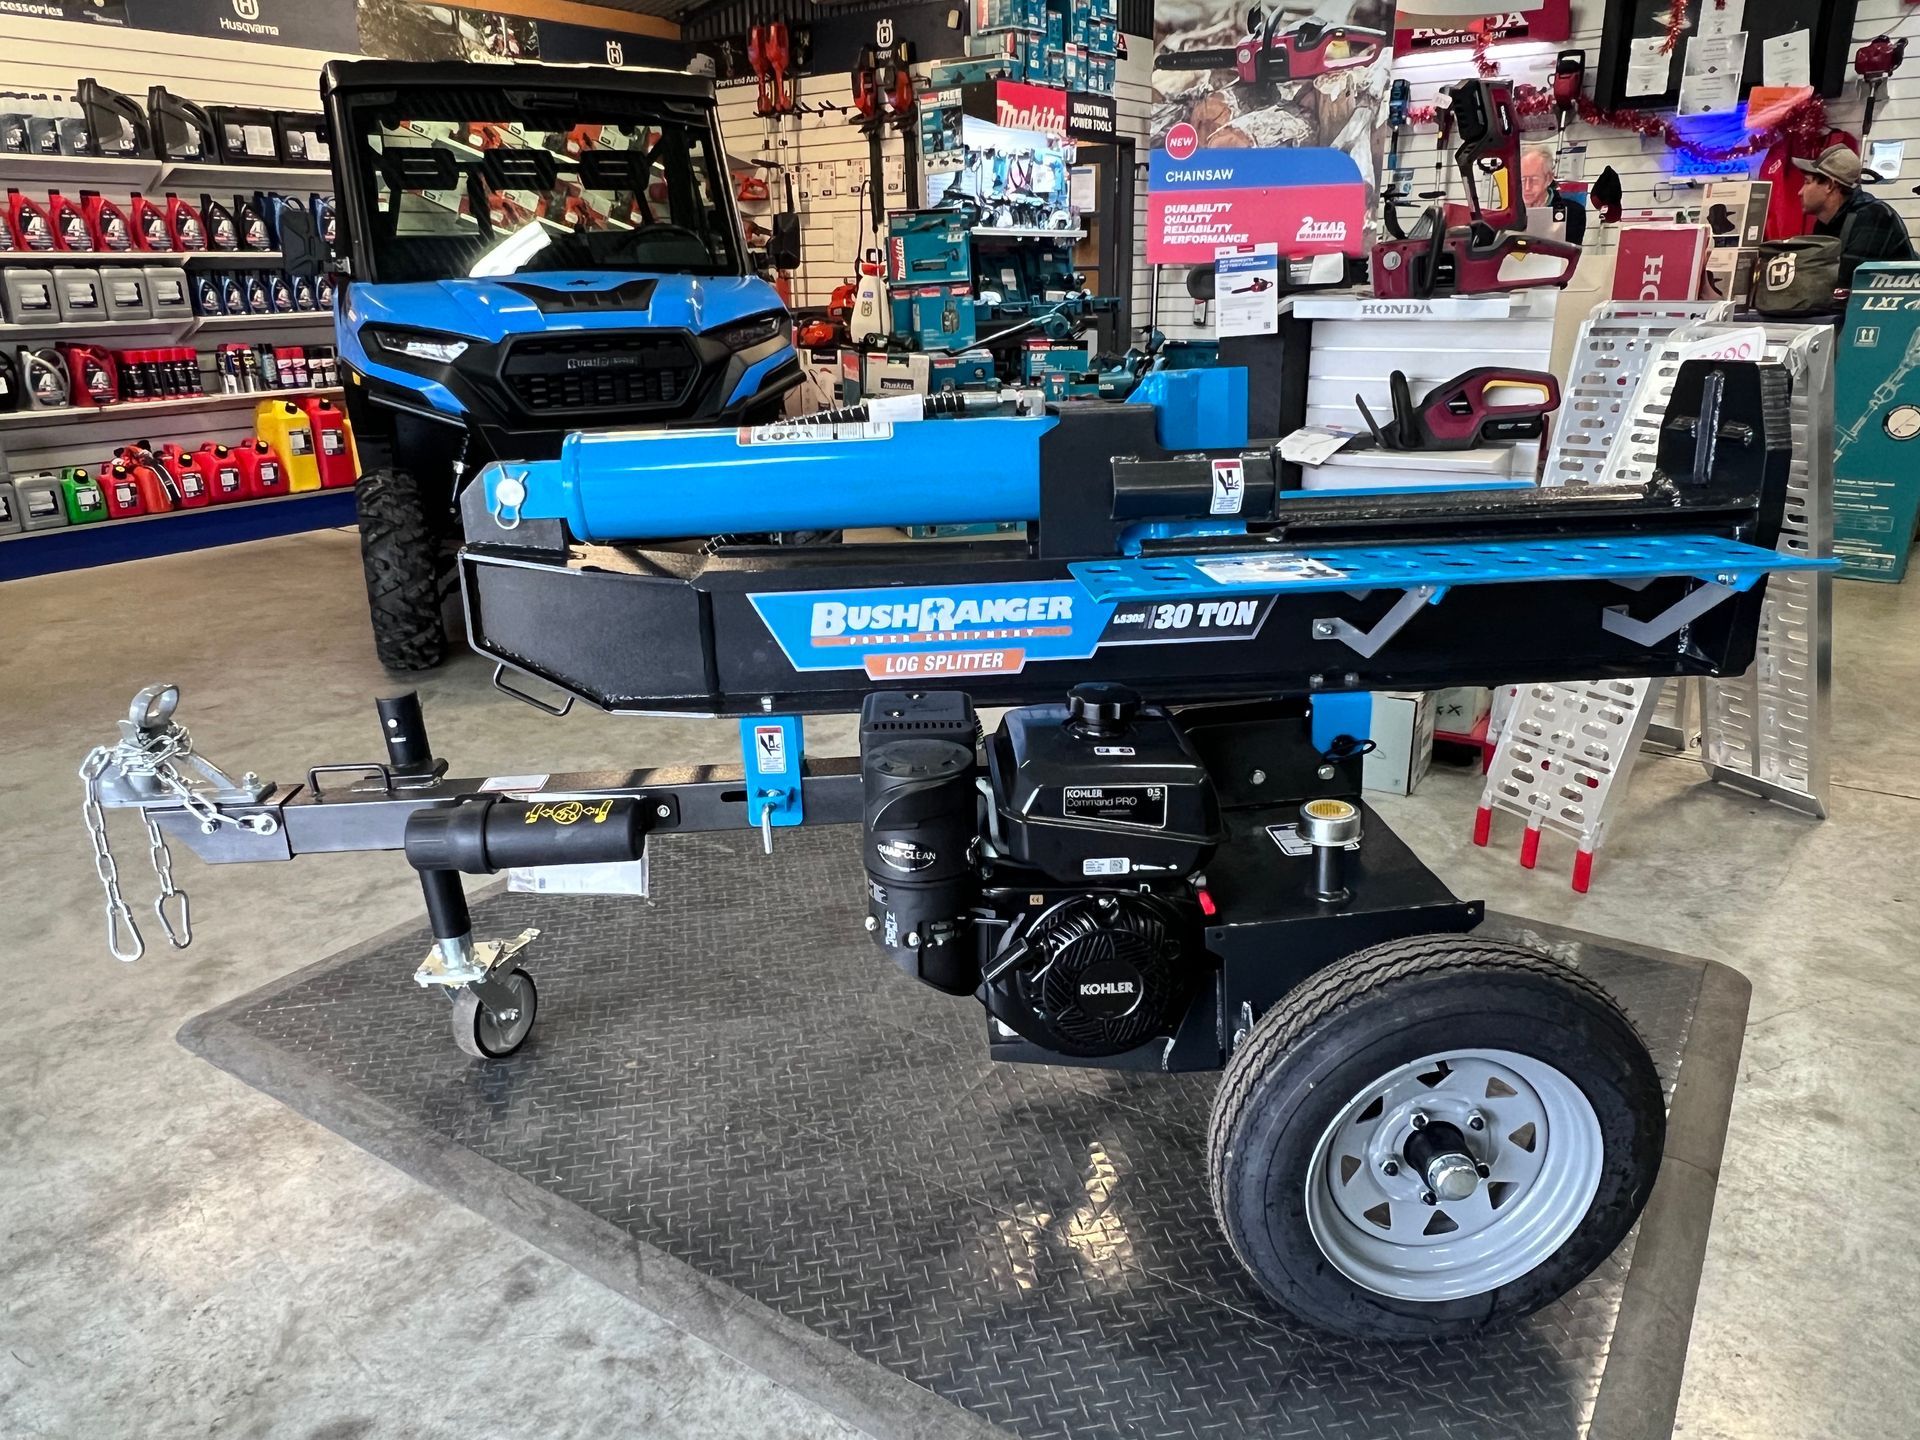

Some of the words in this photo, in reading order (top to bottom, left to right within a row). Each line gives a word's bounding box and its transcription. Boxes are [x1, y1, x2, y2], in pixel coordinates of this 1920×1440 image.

[0, 1, 63, 16] cessories
[220, 17, 280, 36] Husqvarna
[1074, 102, 1109, 119] INDUSTRIAL
[1070, 116, 1092, 130] POWER
[1093, 119, 1113, 132] TOOLS
[1169, 137, 1193, 147] NEW
[1165, 168, 1234, 183] CHAINSAW
[1164, 203, 1232, 214] DURABILITY
[1164, 214, 1212, 224] QUALITY
[1163, 224, 1232, 234] RELIABILITY
[1163, 234, 1249, 245] PERFORMANCE
[1362, 304, 1433, 314] HONDA
[1862, 296, 1905, 310] LXT
[883, 381, 912, 390] Makita
[1154, 603, 1194, 629] 30
[1196, 601, 1259, 627] TON
[850, 634, 911, 645] POWER
[925, 629, 1035, 642] EQUIPMENT
[885, 656, 918, 673] LOG
[923, 652, 1005, 672] SPLITTER
[1067, 789, 1103, 798] KOHLER
[1067, 798, 1113, 807] Command
[1115, 797, 1137, 806] PRO
[1080, 981, 1134, 995] KOHLER
